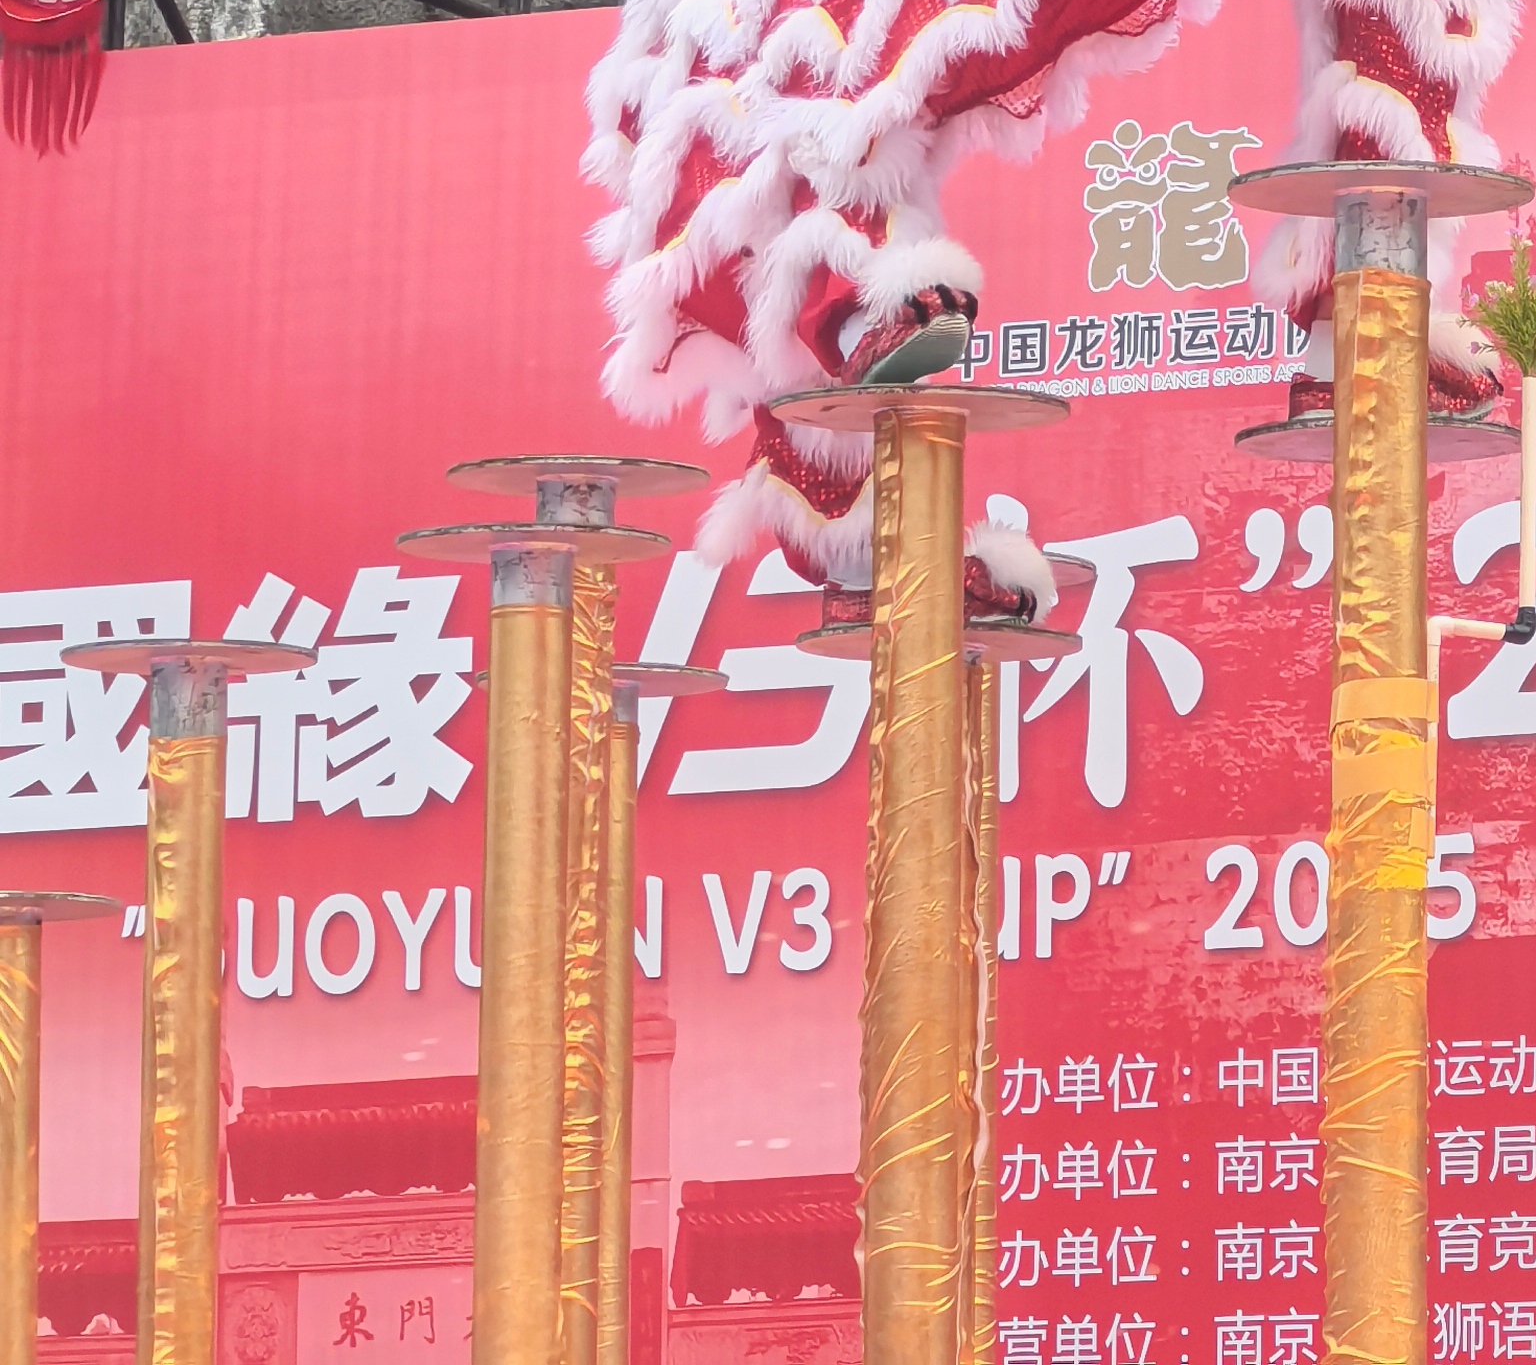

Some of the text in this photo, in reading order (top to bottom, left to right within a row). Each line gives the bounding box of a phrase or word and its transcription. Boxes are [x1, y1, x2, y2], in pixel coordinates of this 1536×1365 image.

[1109, 373, 1150, 394] LION
[1153, 369, 1208, 391] DANCE
[1213, 364, 1271, 385] SPORTS
[702, 866, 832, 975] V3
[1204, 830, 1478, 949] 205
[333, 1291, 472, 1348] 東門
